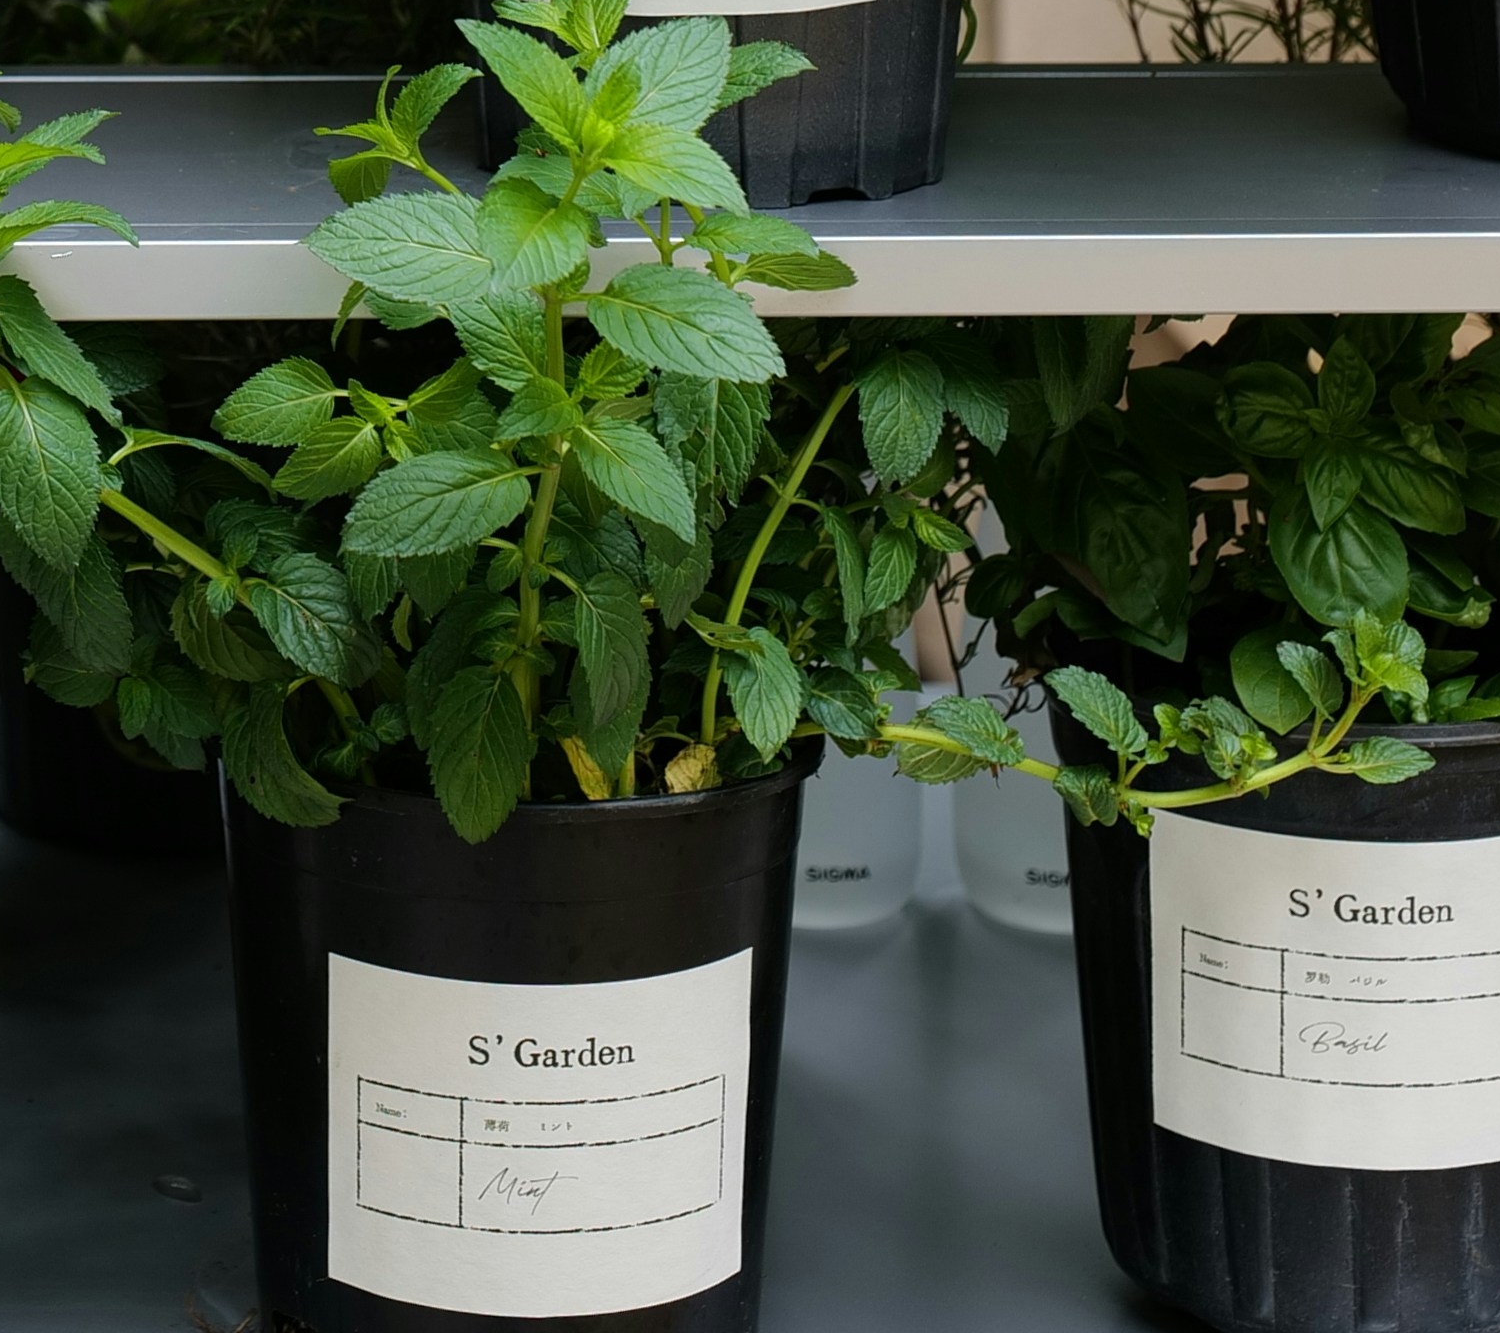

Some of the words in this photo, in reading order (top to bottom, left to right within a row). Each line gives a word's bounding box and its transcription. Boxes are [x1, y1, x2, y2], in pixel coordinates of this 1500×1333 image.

[804, 864, 872, 884] SIGMA
[1288, 888, 1324, 918] S'
[1333, 893, 1455, 926] Garden
[1198, 952, 1229, 970] Name:
[467, 1034, 504, 1066] S'
[513, 1036, 636, 1069] Garden
[1298, 1021, 1388, 1055] Basil
[375, 1102, 407, 1119] Name:
[477, 1166, 579, 1216] Mint
